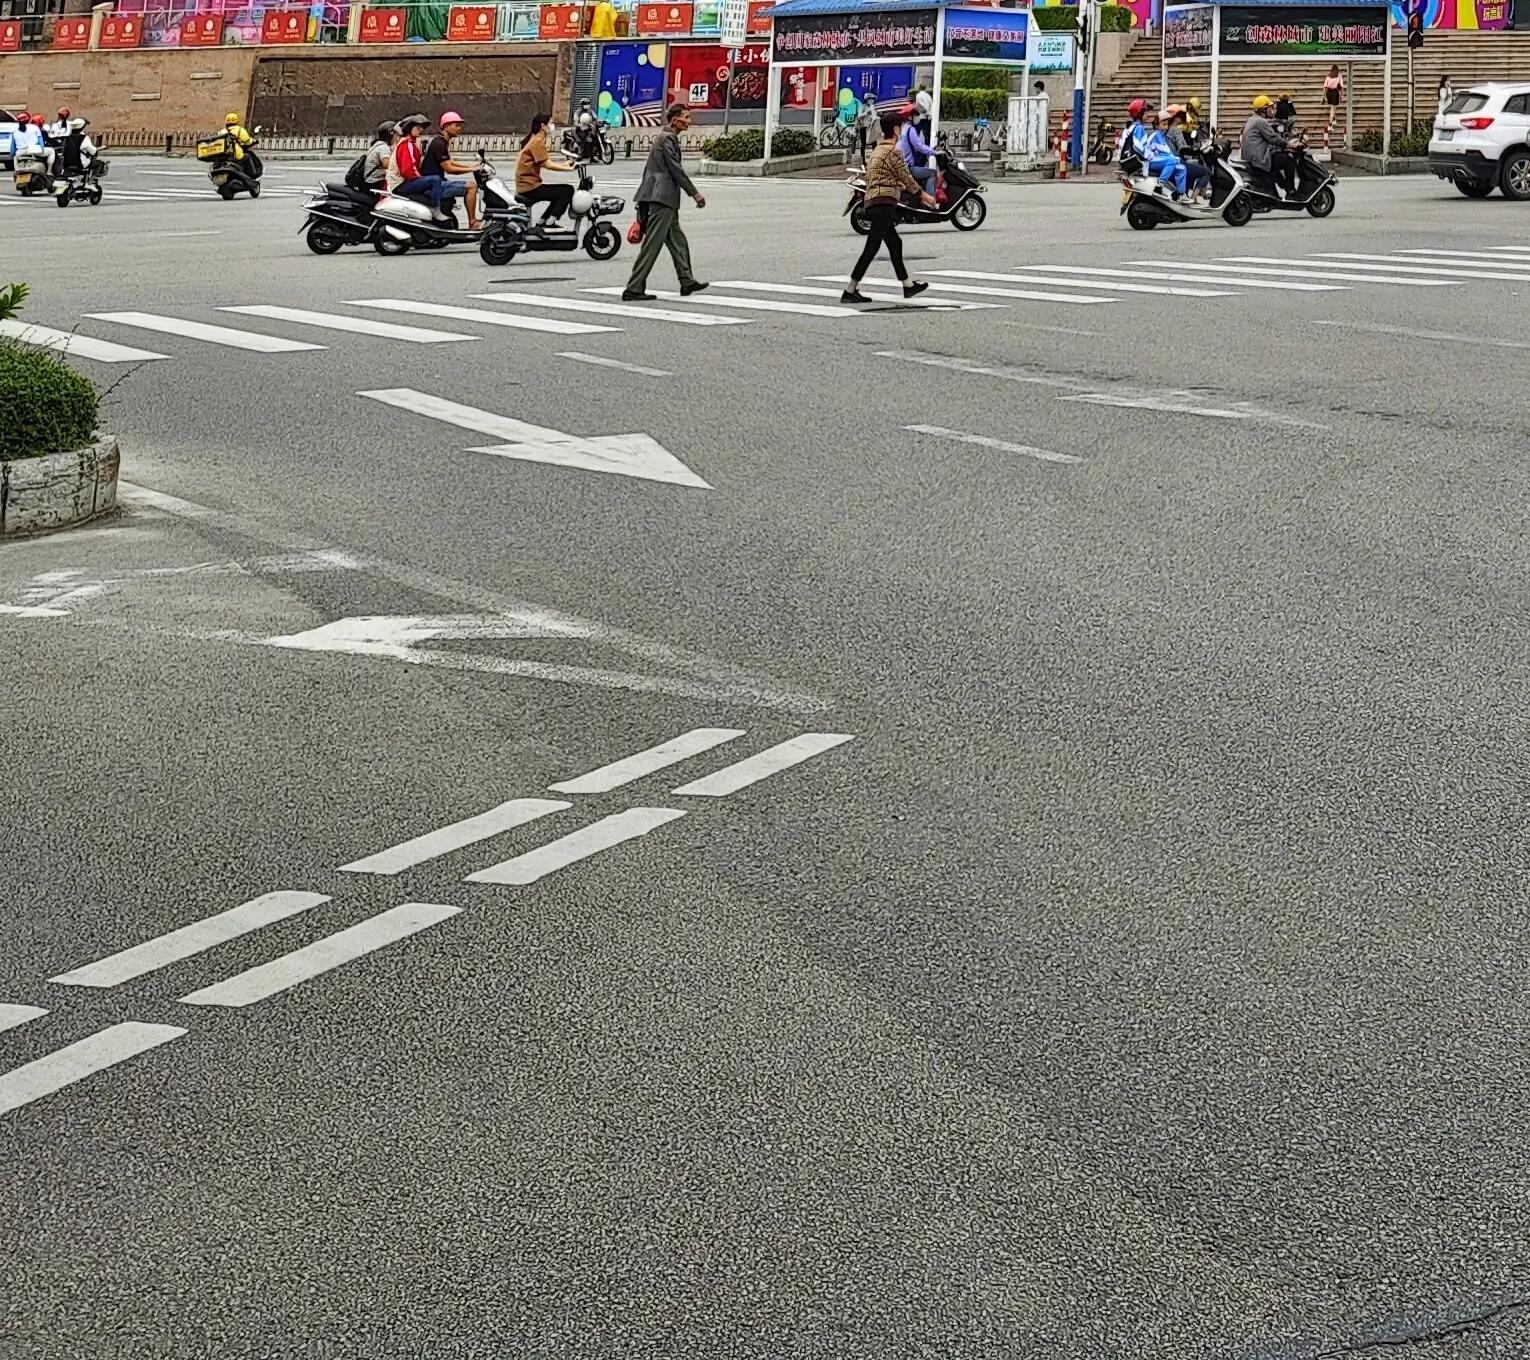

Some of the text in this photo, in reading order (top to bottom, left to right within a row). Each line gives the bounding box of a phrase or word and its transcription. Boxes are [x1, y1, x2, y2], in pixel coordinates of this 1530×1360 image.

[1245, 23, 1313, 45] 创森林城市
[691, 85, 707, 98] 4F
